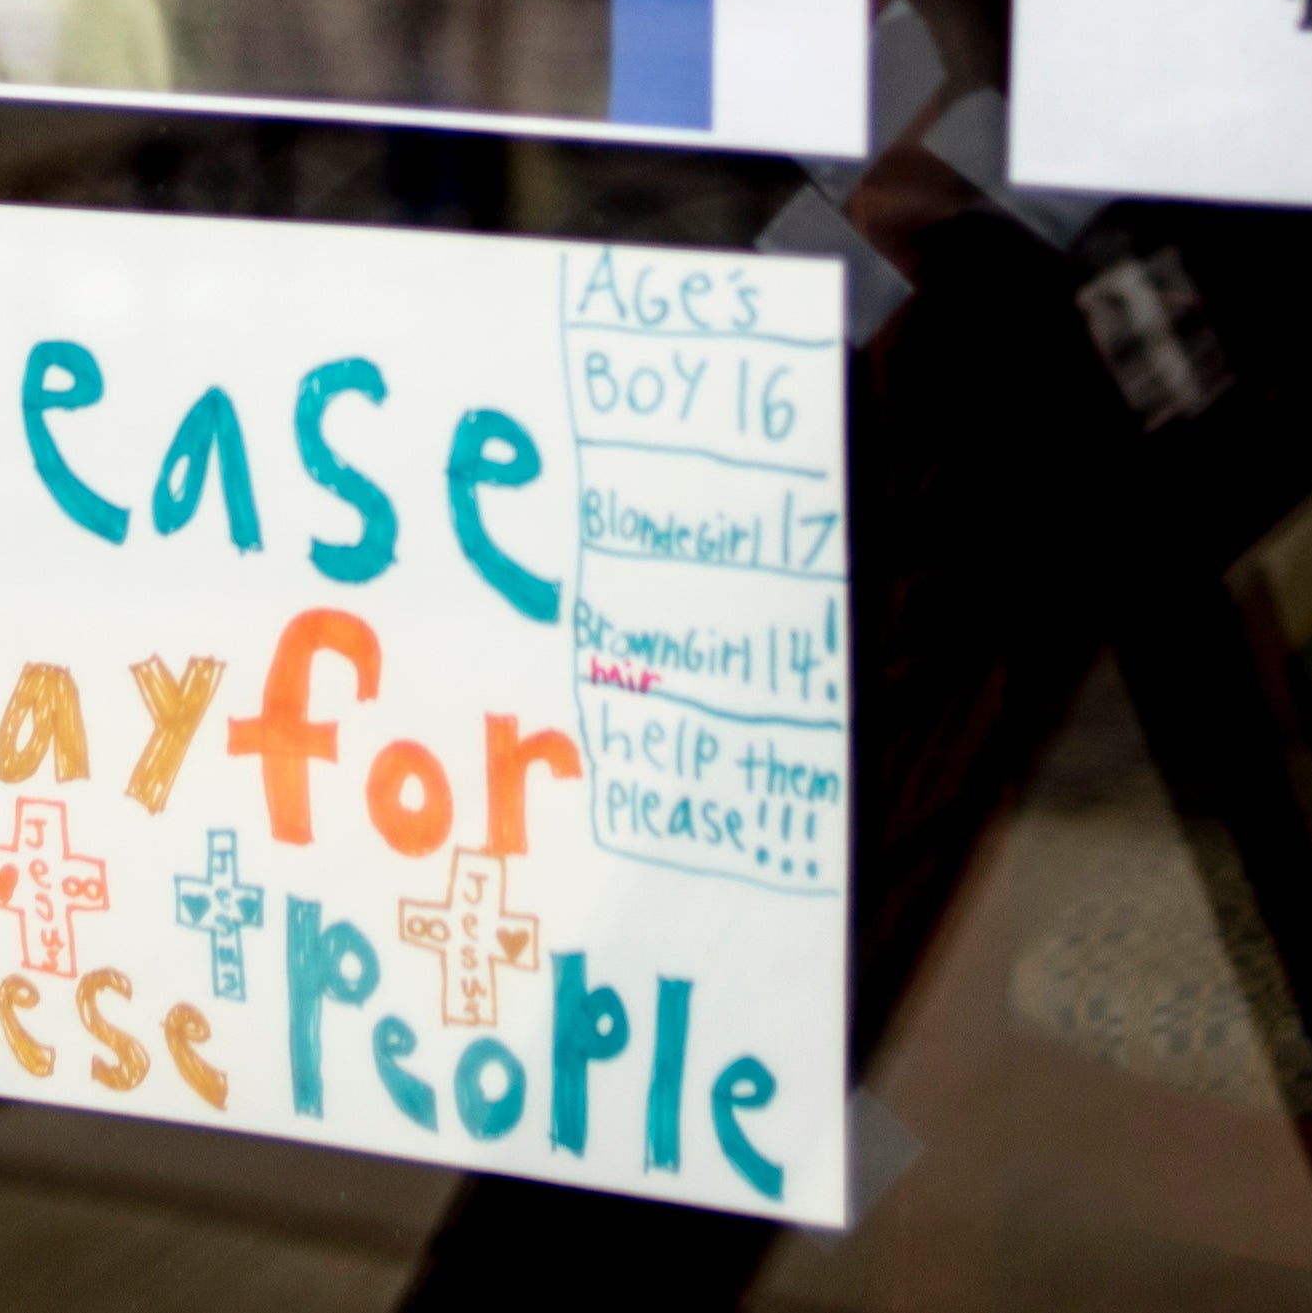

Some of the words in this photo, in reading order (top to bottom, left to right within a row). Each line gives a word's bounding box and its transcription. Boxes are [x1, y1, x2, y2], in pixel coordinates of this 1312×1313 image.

[738, 358, 797, 443] 16
[783, 490, 840, 568] 17
[227, 607, 584, 858] for
[602, 700, 720, 781] help
[736, 739, 840, 806] them
